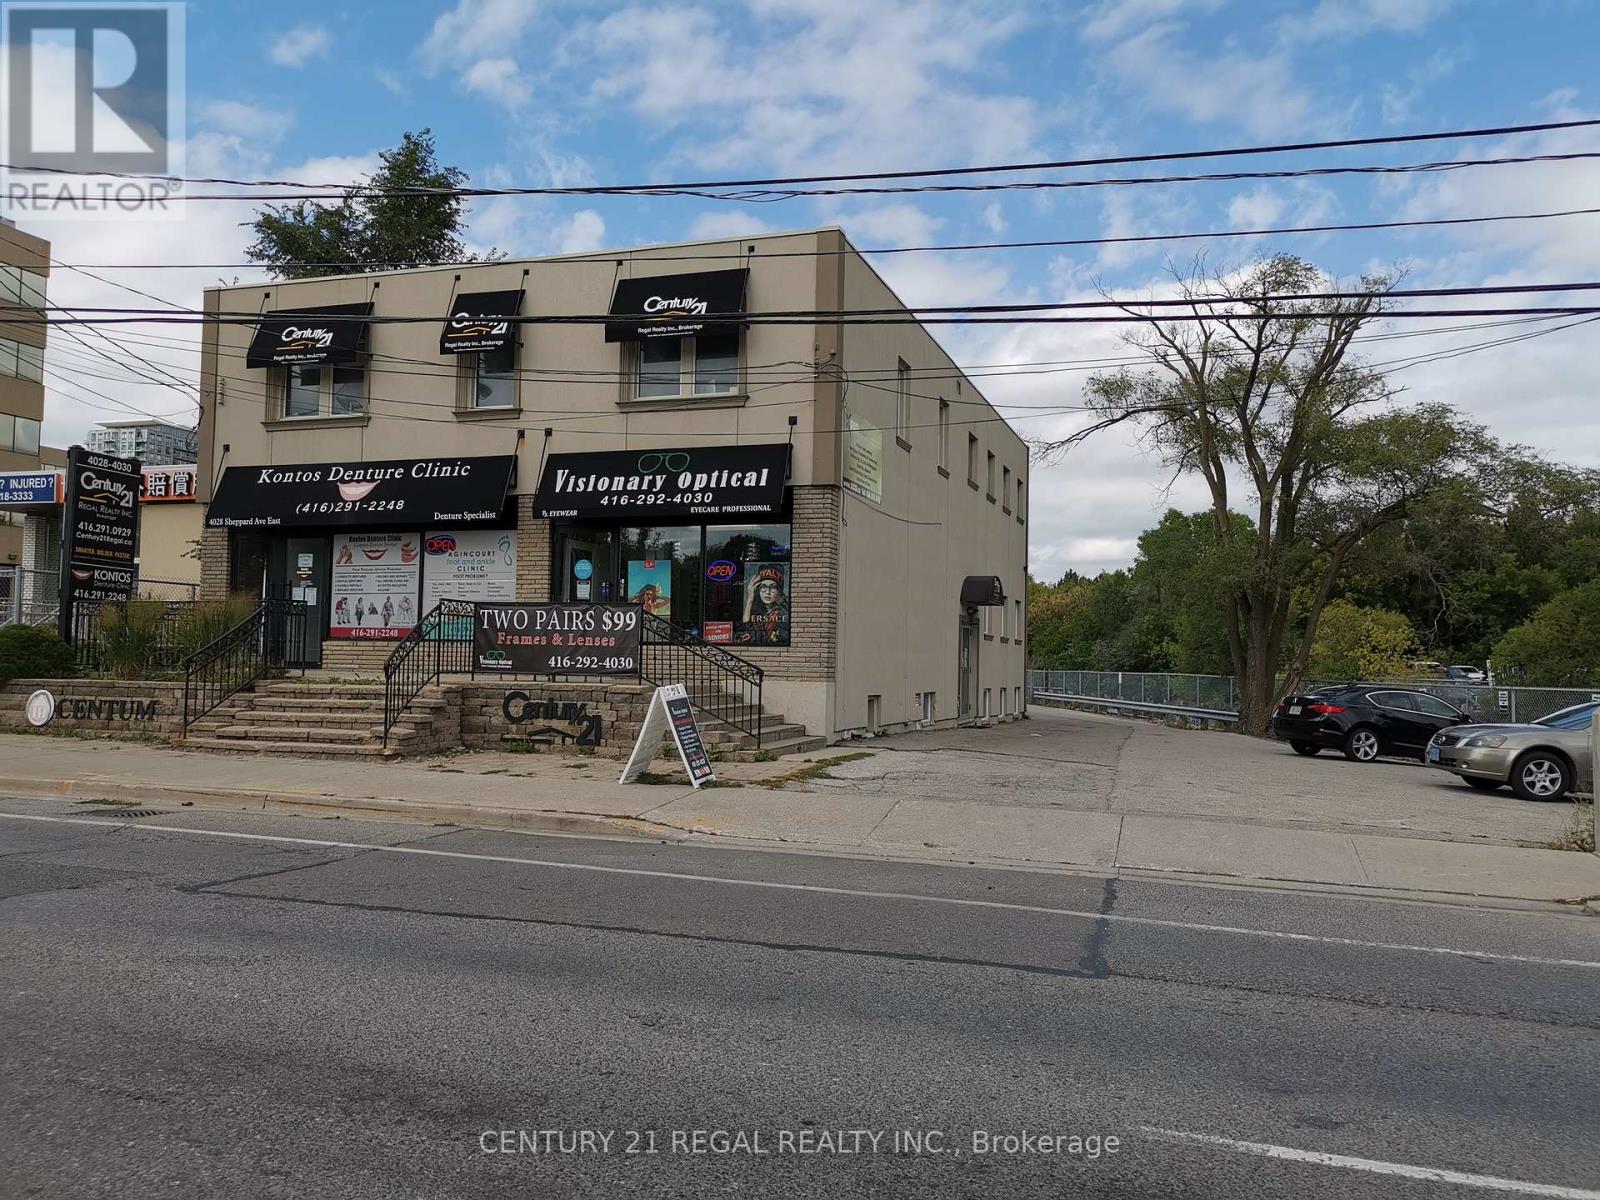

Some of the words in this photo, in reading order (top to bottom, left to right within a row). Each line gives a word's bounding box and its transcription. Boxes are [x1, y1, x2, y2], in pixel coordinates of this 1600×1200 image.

[644, 296, 698, 313] Century
[691, 302, 707, 315] 21
[281, 326, 327, 341] Century
[316, 332, 334, 347] 21
[87, 455, 132, 473] 4028-4030
[257, 469, 322, 484] Kontos
[328, 466, 404, 482] Denture
[411, 462, 471, 478] Clinic
[139, 471, 197, 497] 賠償
[554, 469, 667, 493] Visionary
[677, 468, 769, 491] Optical
[80, 471, 126, 496] Century
[120, 490, 133, 508] 21
[600, 492, 713, 506] 416-292-4030
[295, 499, 405, 514] (416)291-2248
[549, 509, 578, 517] EYEWEAR
[722, 504, 772, 512] PROFESSIONAL
[209, 517, 223, 526] 4028
[224, 517, 253, 527] Sheppard
[254, 517, 266, 525] Ave
[267, 516, 281, 525] East
[434, 511, 462, 521] Denture
[463, 511, 496, 521] Specialist
[78, 521, 132, 537] 416.291.0929
[427, 539, 457, 551] OPEN
[94, 569, 131, 583] KONTOS
[708, 564, 734, 577] OPEN
[73, 588, 127, 602] 416.291.2248
[479, 609, 528, 629] TWO
[535, 610, 595, 630] PAIRS
[601, 610, 637, 632] $99
[351, 629, 399, 637] 416-291-2248
[496, 632, 547, 646] Frames
[551, 633, 563, 646] &
[567, 633, 616, 646] Lenses
[548, 656, 633, 669] 416-292-4030
[56, 698, 157, 721] CENTUM
[502, 691, 587, 726] Century
[576, 715, 602, 746] 21
